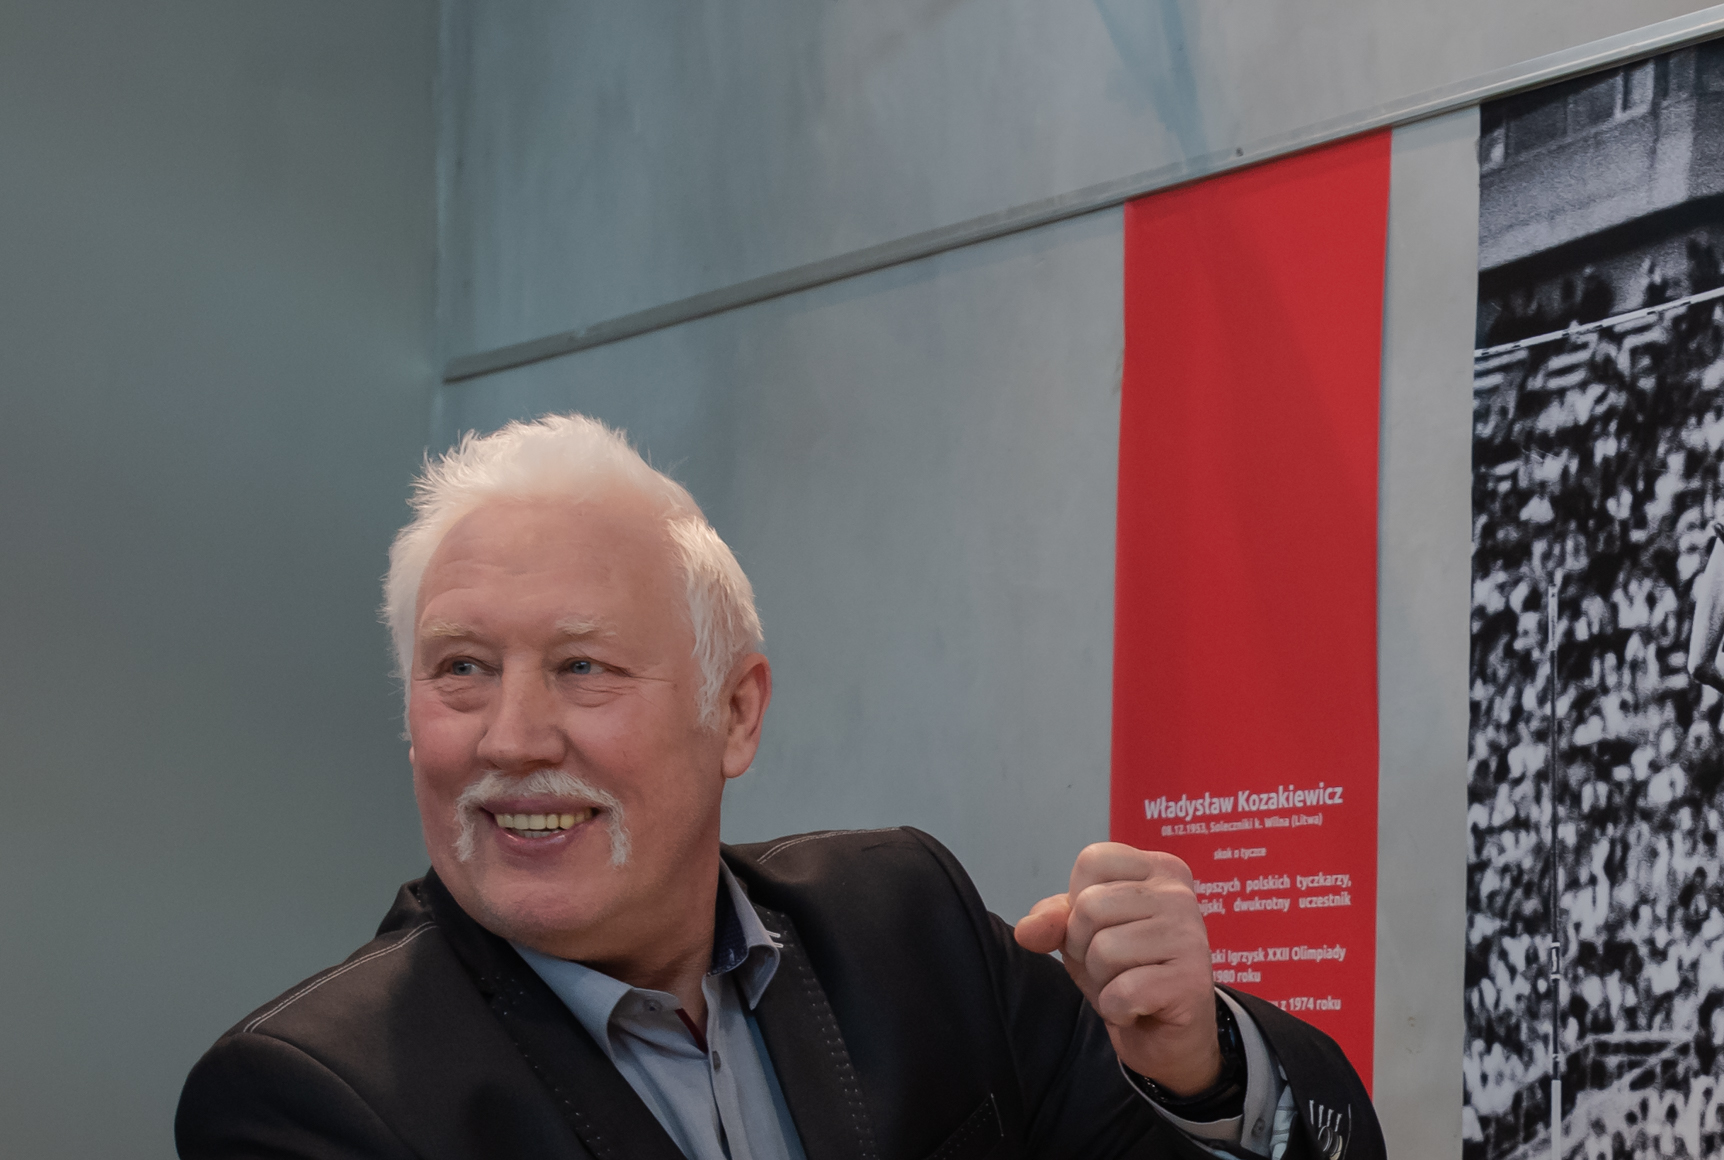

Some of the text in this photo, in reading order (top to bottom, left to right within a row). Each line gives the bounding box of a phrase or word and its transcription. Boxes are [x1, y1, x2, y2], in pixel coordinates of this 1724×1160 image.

[1144, 781, 1344, 821] Władysław Kozakiewicz
[1291, 813, 1323, 828] (Litwa)
[1213, 847, 1233, 860] skok
[1234, 848, 1240, 858] o
[1246, 874, 1290, 893] polskich
[1296, 872, 1352, 890] tyczkarzy,
[1233, 896, 1290, 912] dwukrotny
[1298, 891, 1351, 908] uczestnik
[1210, 944, 1346, 965] ski Igrzysk XXII Olimpiady
[1237, 968, 1261, 983] roku
[1289, 997, 1315, 1011] 1974
[1316, 995, 1342, 1010] roku
